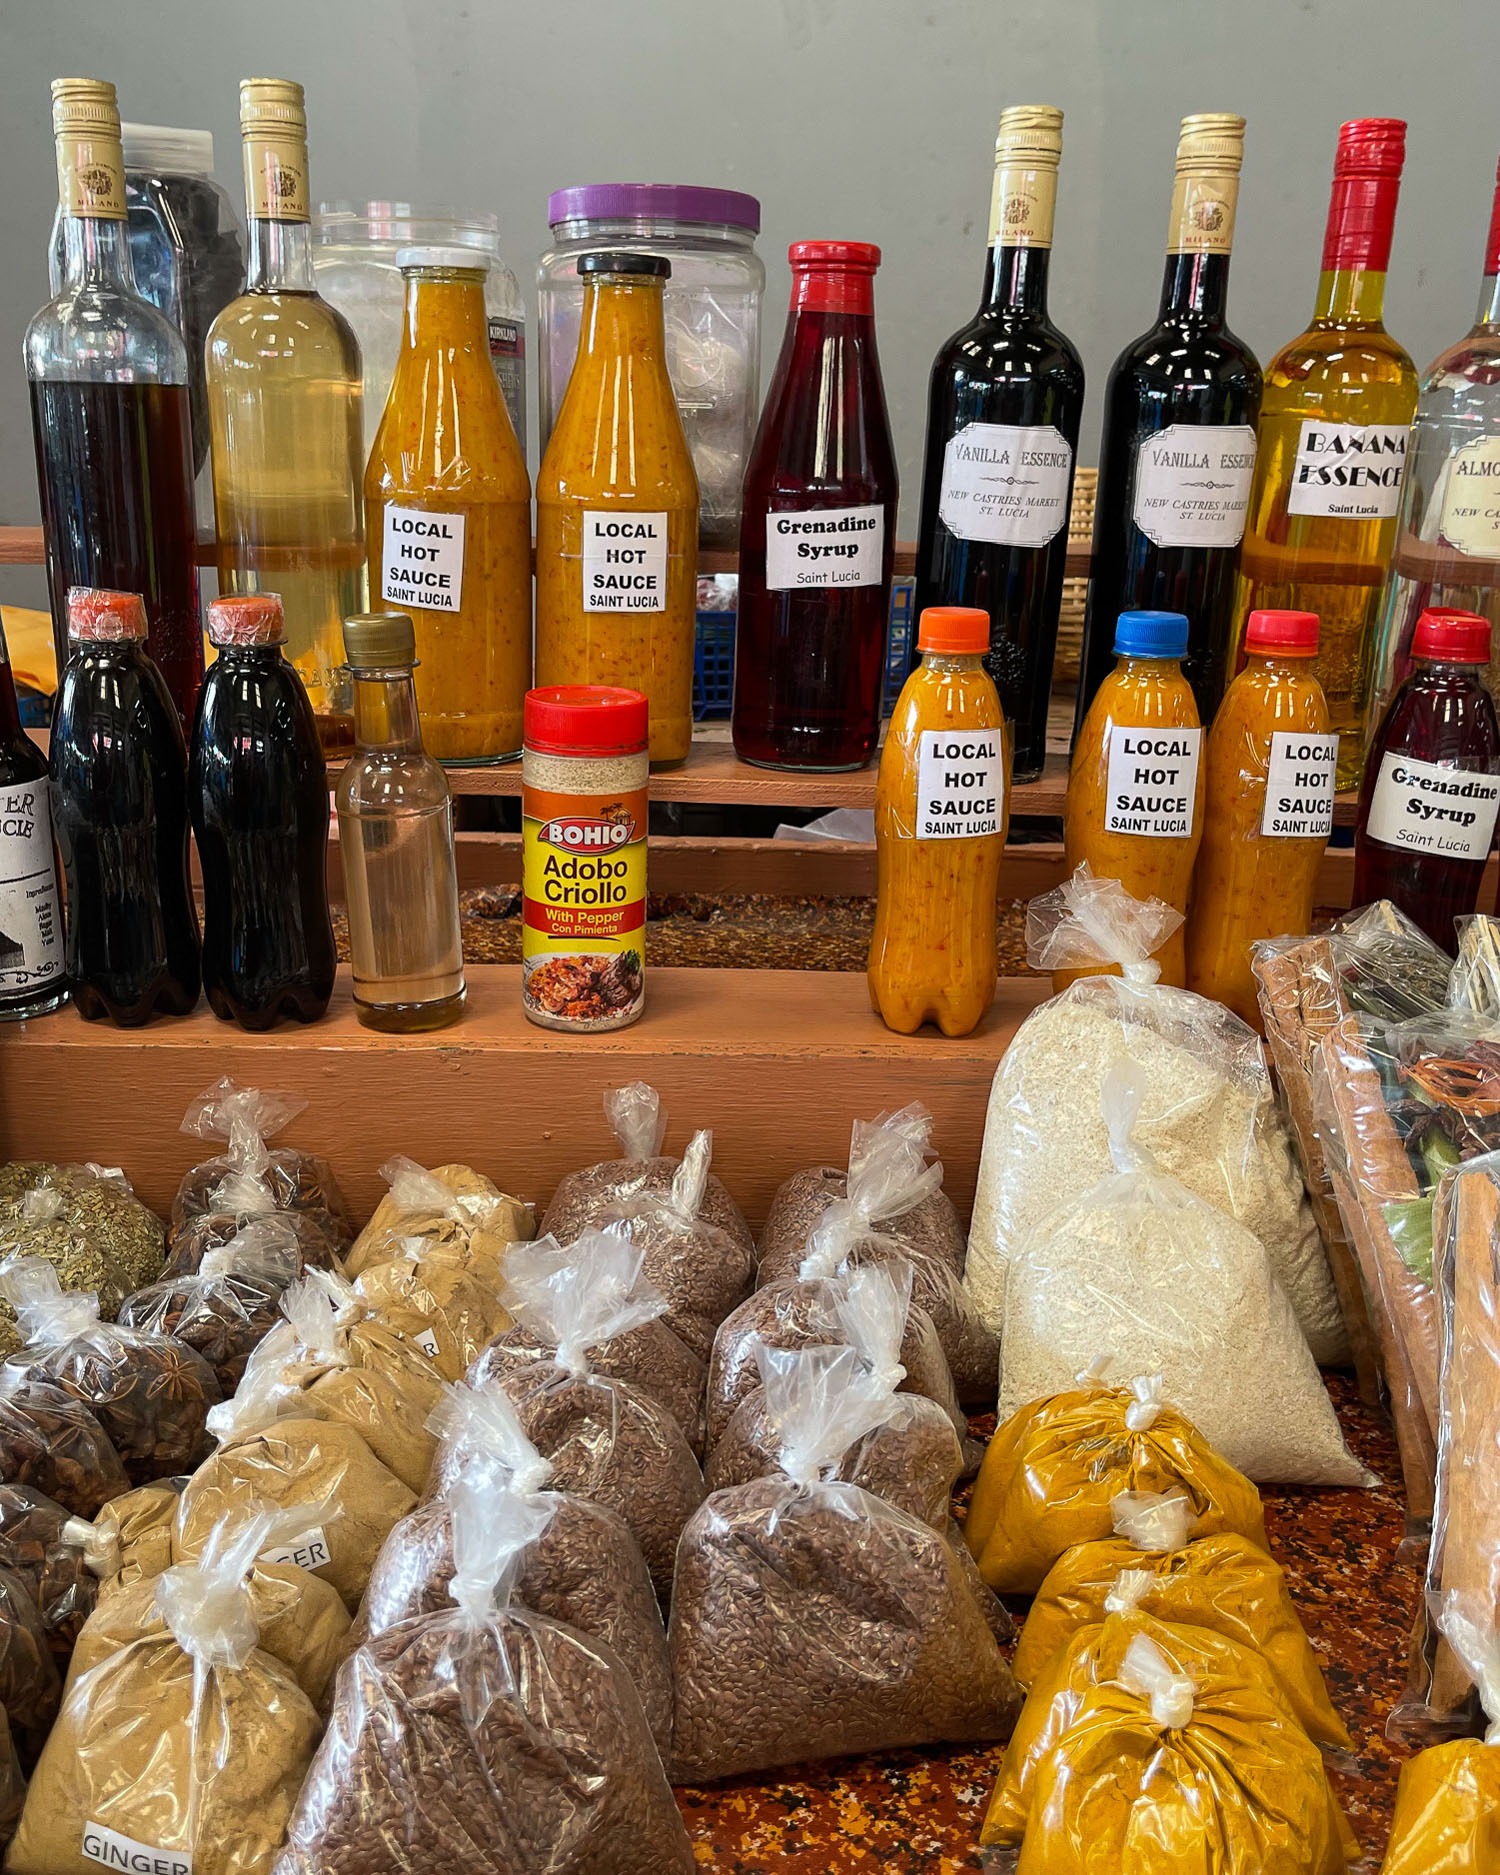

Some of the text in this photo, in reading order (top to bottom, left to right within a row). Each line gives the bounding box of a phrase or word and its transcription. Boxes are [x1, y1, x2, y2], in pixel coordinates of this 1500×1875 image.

[1306, 432, 1405, 454] BANANA
[955, 444, 1067, 468] VANILLA ESSENCE
[1153, 449, 1210, 469] VANILLA
[1299, 464, 1402, 487] ESSENCE
[948, 490, 1060, 507] NEW CASTRIES MARKET
[1144, 498, 1169, 508] NEW
[1172, 500, 1220, 510] CASTRIES
[979, 507, 1030, 518] ST. LUCIA
[1180, 512, 1226, 521] ST. LUCIA
[1328, 504, 1379, 514] Saint Lucia
[1452, 508, 1480, 517] NEW
[392, 517, 453, 539] LOCAL
[595, 523, 657, 538] LOCAL
[777, 516, 876, 534] Grenadine
[401, 544, 440, 562] HOT
[606, 549, 646, 564] HOT
[797, 543, 859, 560] Syrup
[390, 567, 451, 589] SAUCE
[593, 574, 657, 589] SAUCE
[796, 570, 860, 584] Saint Lucia
[387, 586, 453, 607] SAINT LUCIA
[590, 594, 659, 608] SAINT LUCIA
[933, 743, 996, 759] LOCAL
[1124, 739, 1191, 757] LOCAL
[1285, 745, 1335, 762] LOCAL
[945, 772, 987, 788] HOT
[1134, 768, 1179, 785] HOT
[1295, 772, 1329, 788] HOT
[1391, 767, 1498, 800] Grenadine
[929, 798, 996, 816] SAUCE
[1116, 795, 1187, 813] SAUCE
[1278, 798, 1331, 814] SAUCE
[1406, 798, 1476, 827] Syrup
[0, 819, 35, 839] CIE
[925, 820, 996, 834] SAINT LUCIA
[1111, 816, 1187, 832] SAINT LUCIA
[1272, 819, 1330, 833] SAINT LUCIA
[549, 823, 628, 845] BOHIO
[1396, 829, 1470, 852] Saint Lucia
[543, 855, 628, 880] Adobo
[544, 879, 627, 904] Criollo
[545, 907, 625, 925] With Pepper
[551, 922, 618, 934] Con Pimienta
[83, 1834, 188, 1875] GINGER
